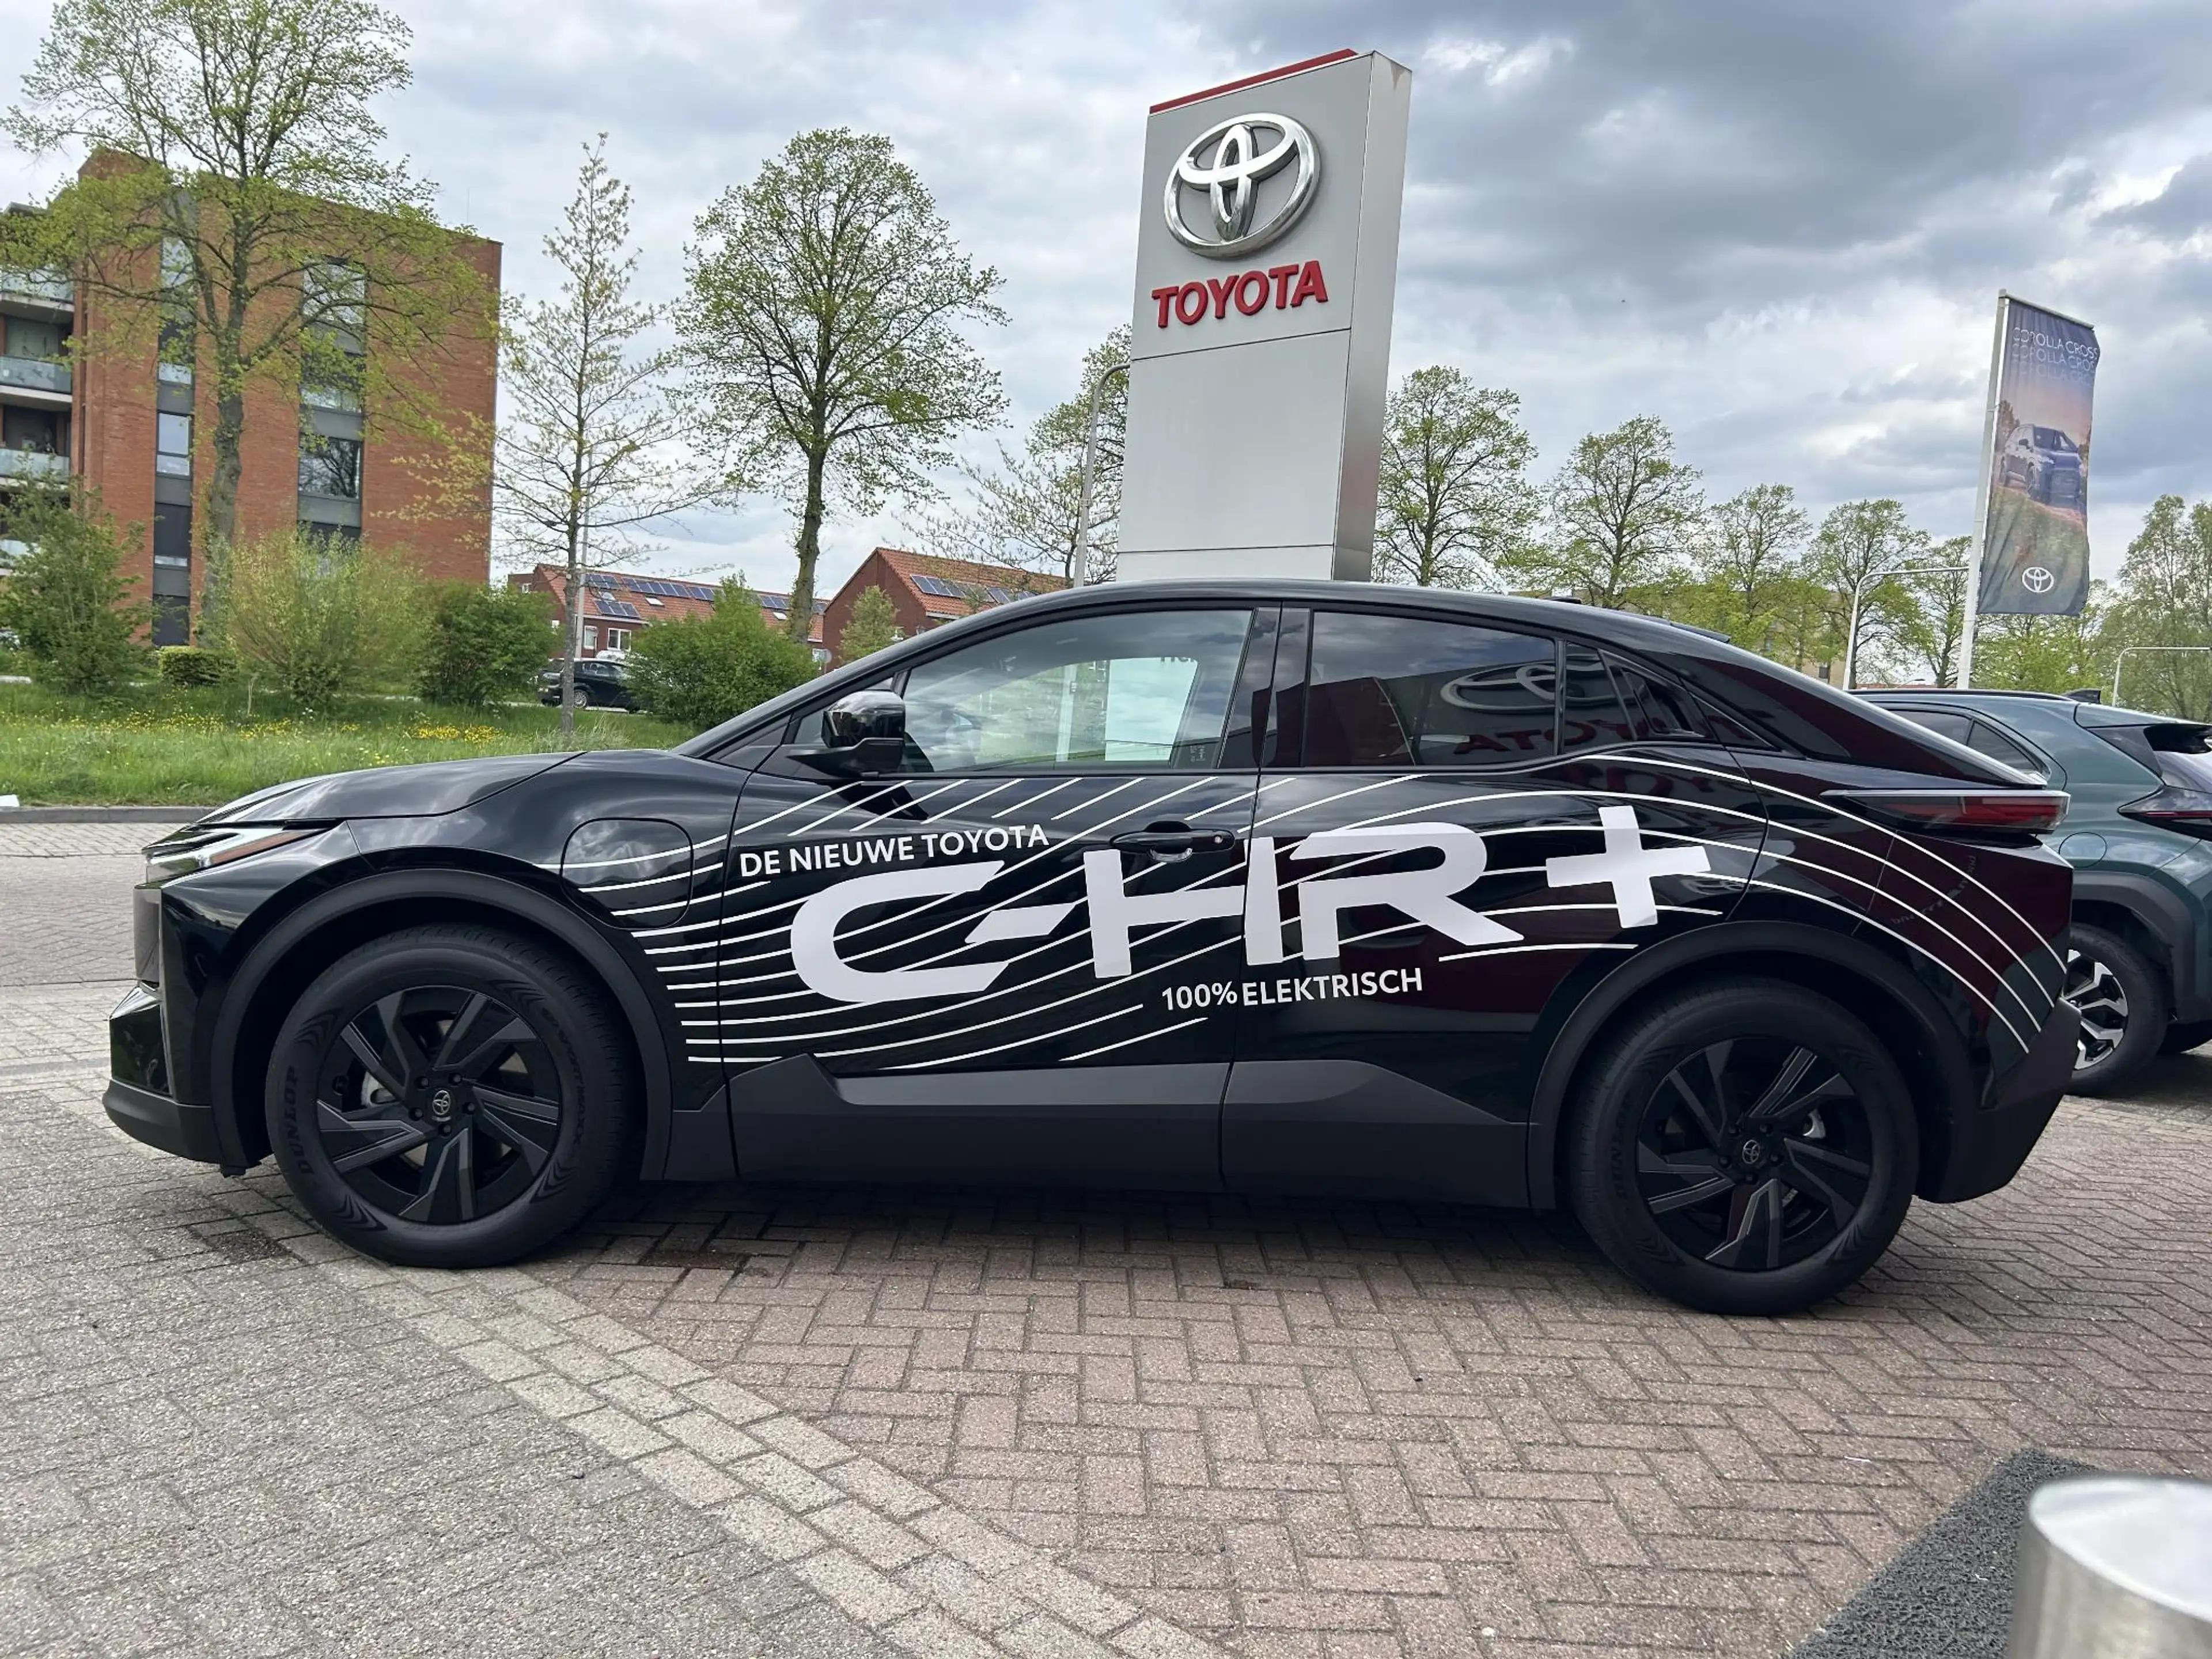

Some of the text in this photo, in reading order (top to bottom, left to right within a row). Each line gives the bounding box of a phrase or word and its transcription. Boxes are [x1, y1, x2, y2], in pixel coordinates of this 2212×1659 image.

[1152, 260, 1328, 328] TOYOTA
[740, 824, 1050, 877] DE NIEUWE TOYOTA
[1161, 967, 1423, 1011] 100% ELEKTRISCH
[285, 1066, 312, 1173] DUNLOP
